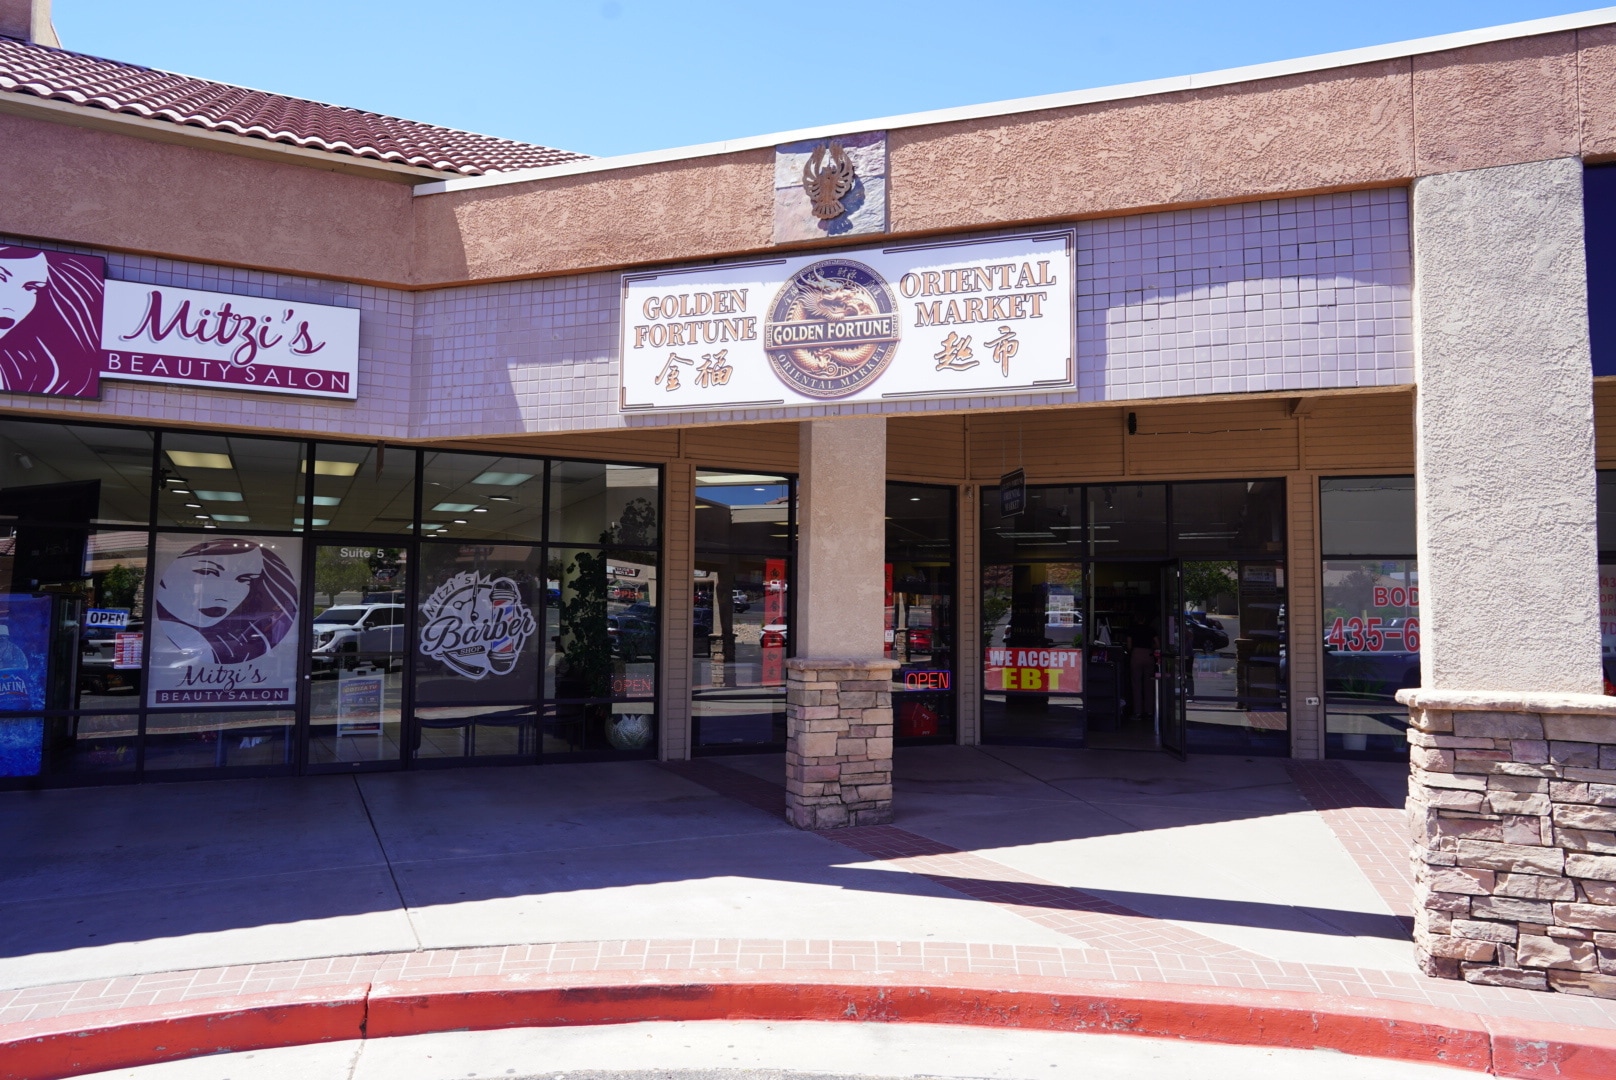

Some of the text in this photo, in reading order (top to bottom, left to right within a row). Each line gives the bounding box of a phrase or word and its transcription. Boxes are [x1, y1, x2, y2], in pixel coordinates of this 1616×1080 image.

[900, 260, 1057, 299] ORIENTAL
[643, 289, 748, 320] GOLDEN
[914, 292, 1047, 328] MARKET
[122, 290, 326, 367] Mitzi's
[633, 317, 757, 349] FORTUNE
[774, 319, 890, 345] GOLDEN FORTUNE
[778, 345, 886, 389] ORIENTAL MARKET
[933, 326, 1020, 378] 超市
[107, 354, 347, 391] BEAUTY SALON
[654, 350, 734, 392] 金福
[340, 547, 385, 559] Suite 5
[425, 575, 471, 617] Mitzi's
[90, 611, 125, 625] OPEN
[423, 607, 534, 652] Barber
[460, 645, 482, 655] SHOP
[989, 650, 1078, 667] WE ACCEPT
[175, 664, 267, 692] Mitzi's
[613, 679, 651, 692] OPEN
[906, 672, 949, 690] OPEN
[1001, 668, 1064, 690] EBT
[161, 690, 284, 701] BEAUTY SALON
